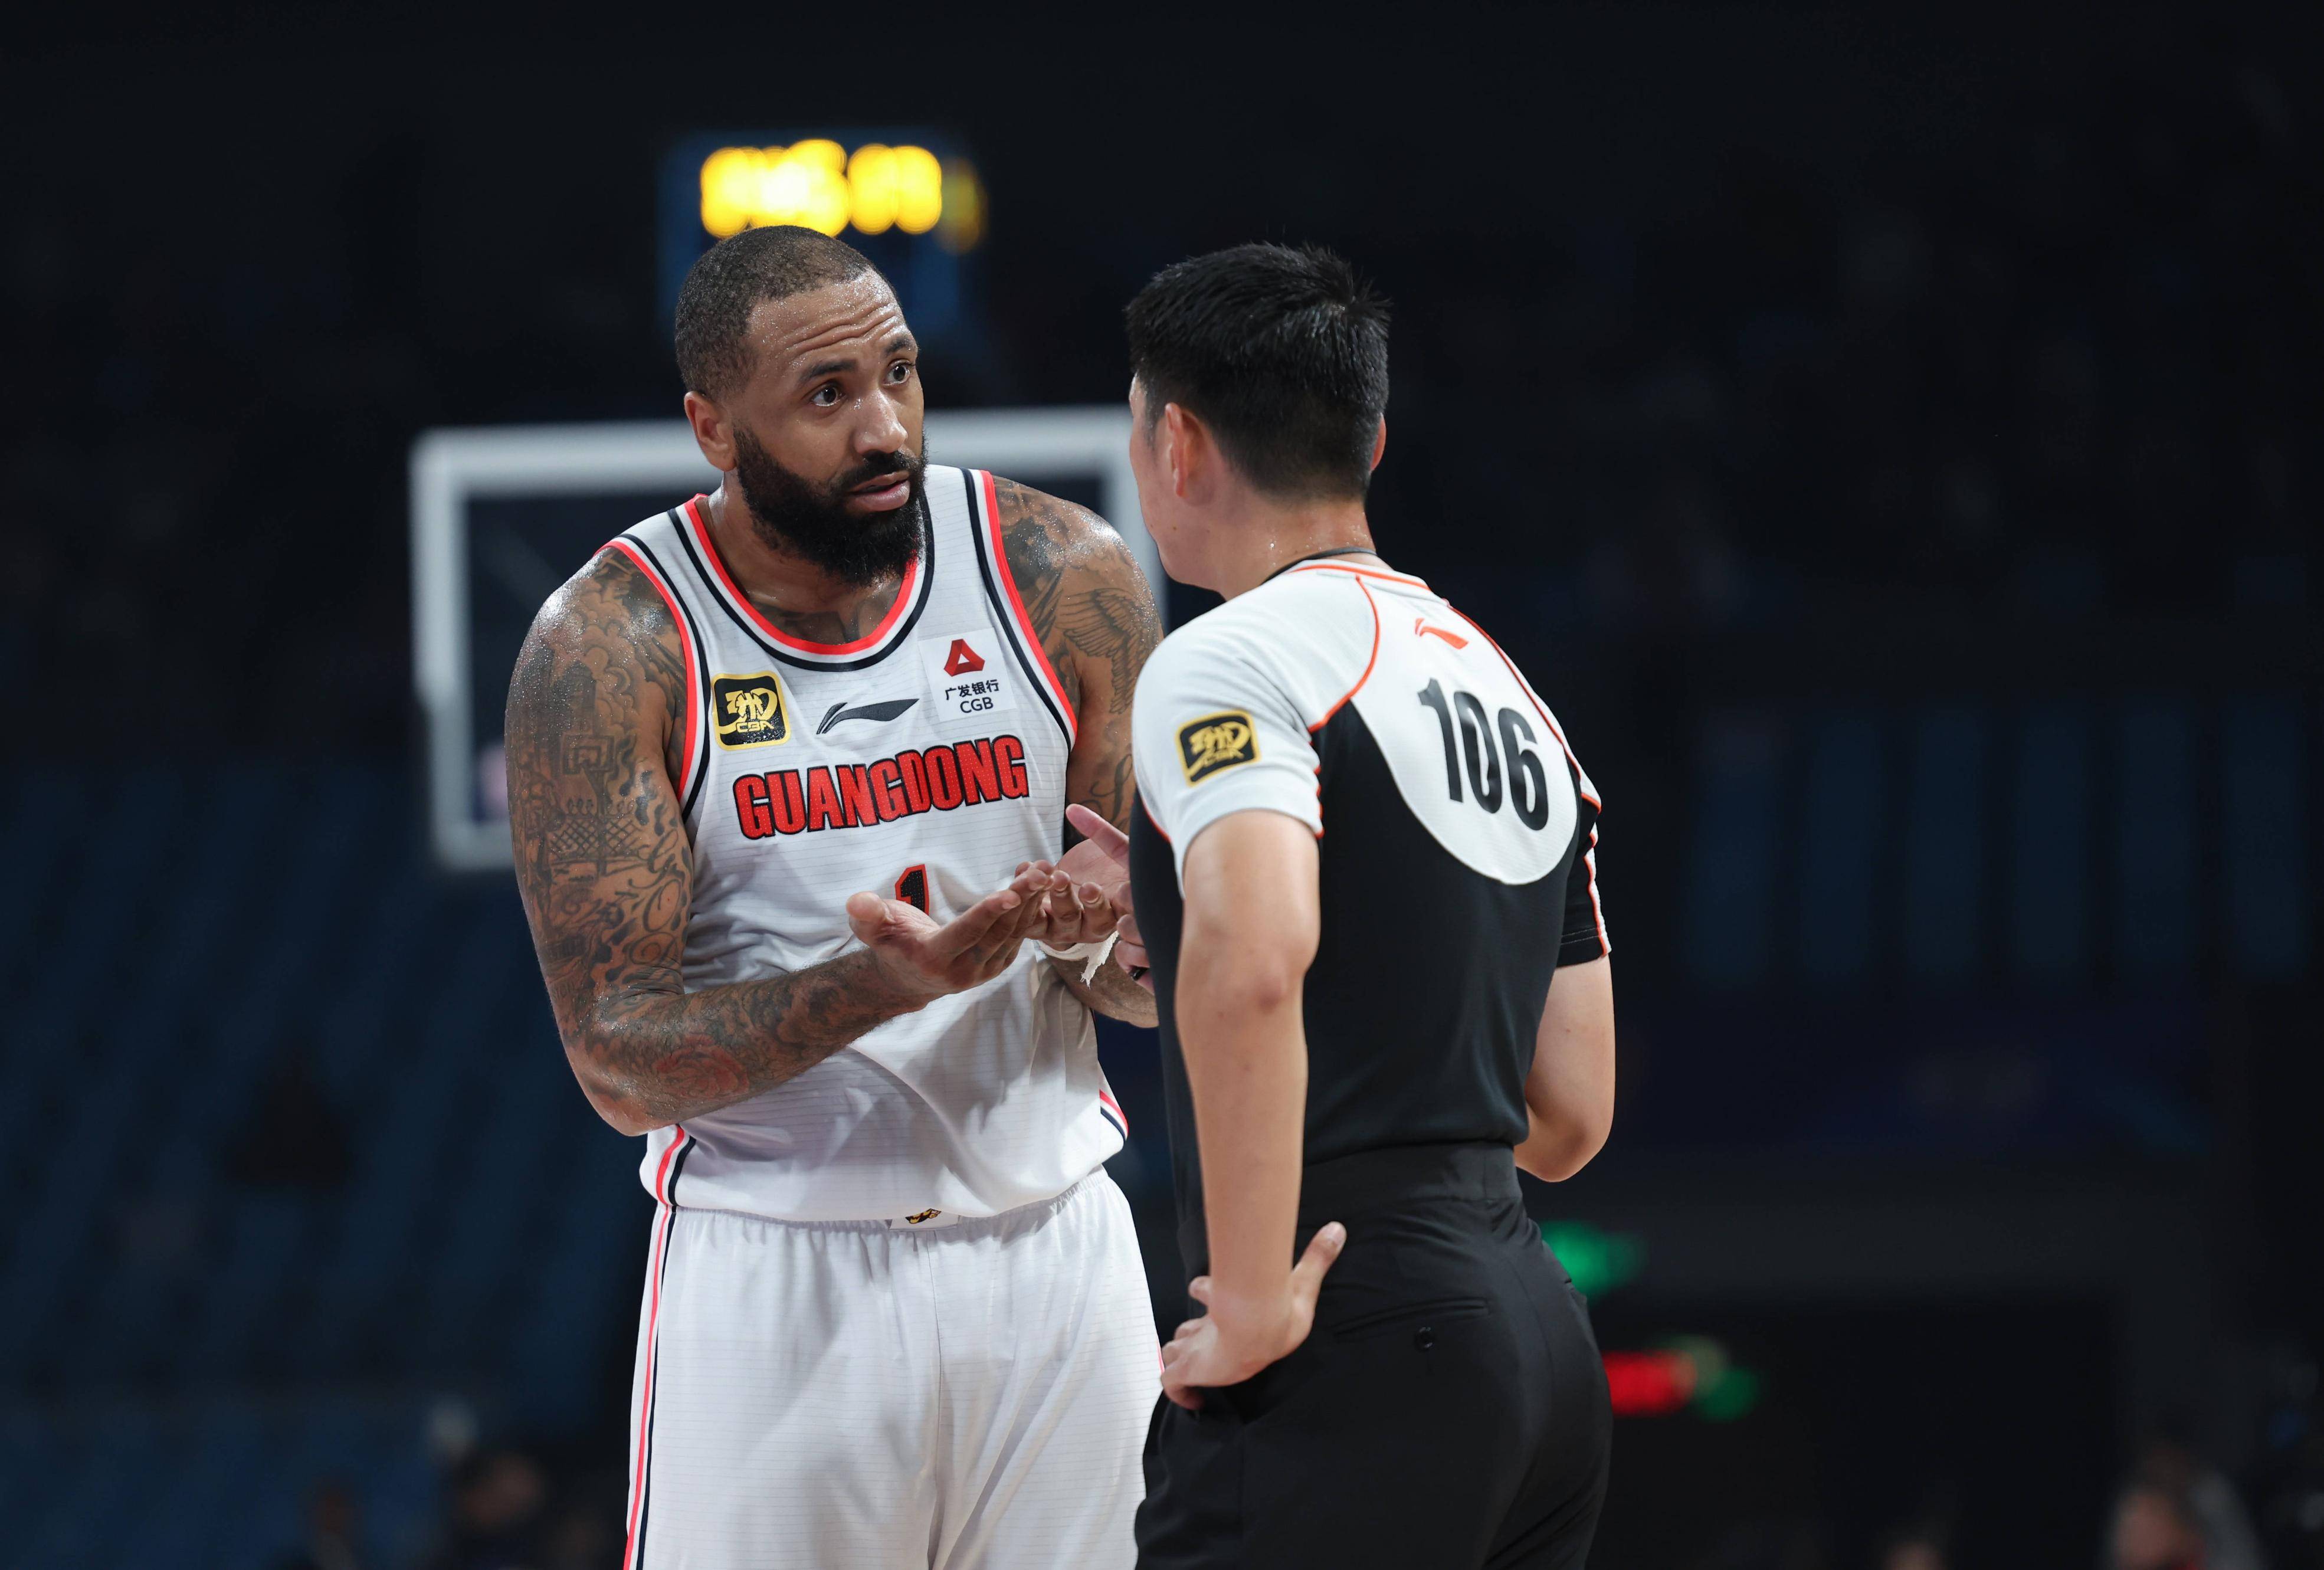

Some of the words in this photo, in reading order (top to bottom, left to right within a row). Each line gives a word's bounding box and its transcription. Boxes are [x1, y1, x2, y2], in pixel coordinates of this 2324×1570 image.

[945, 679, 999, 700] 广发银行
[960, 697, 994, 713] CGB
[736, 720, 774, 733] CBA
[1417, 677, 1549, 831] 106
[733, 735, 1029, 840] GUANGDONG
